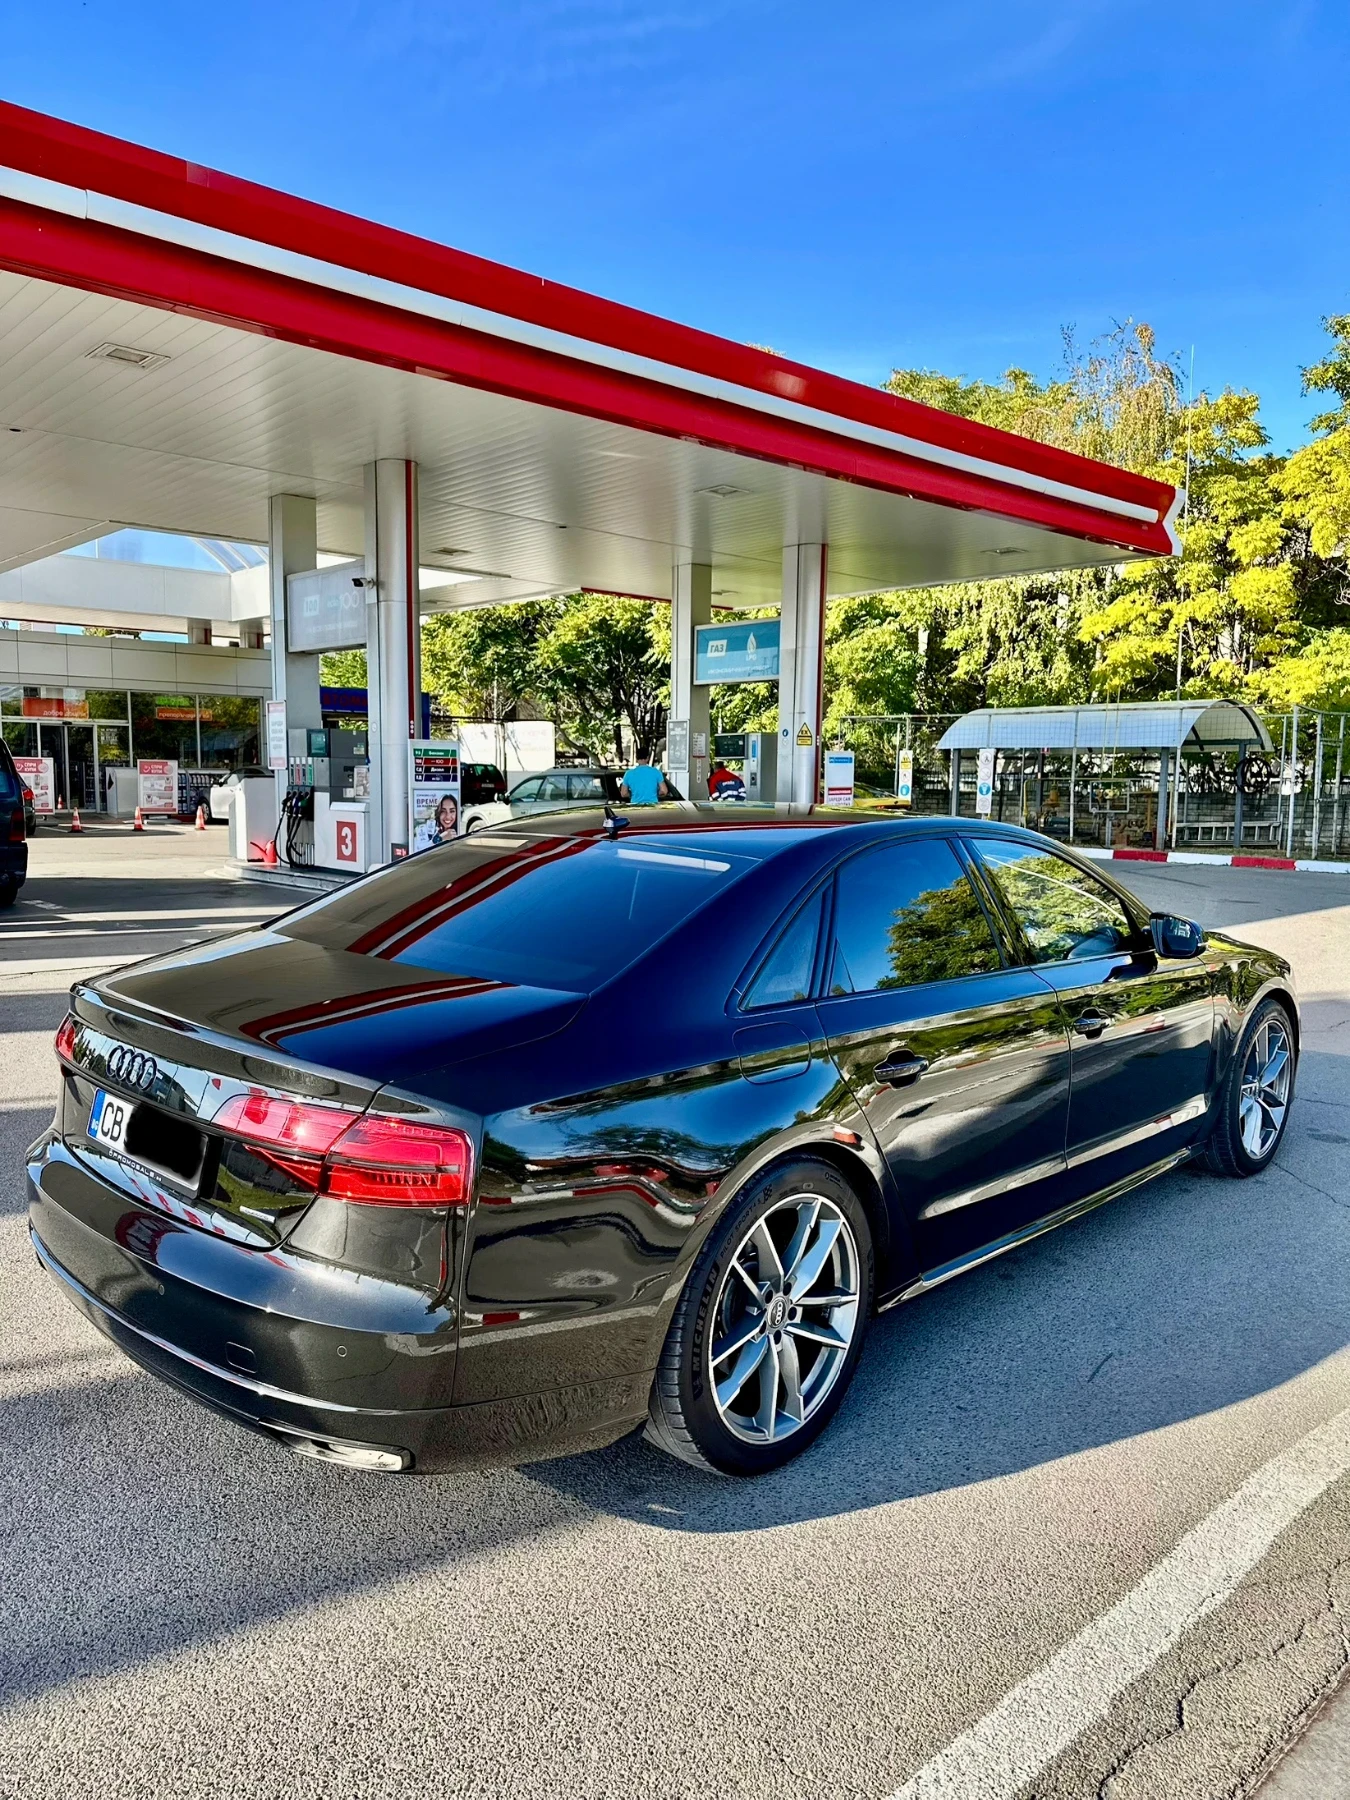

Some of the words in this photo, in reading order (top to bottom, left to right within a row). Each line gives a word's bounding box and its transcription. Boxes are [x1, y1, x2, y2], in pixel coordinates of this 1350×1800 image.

[710, 644, 725, 653] ГАЗ
[341, 826, 353, 857] 3
[720, 1233, 735, 1258] PILOT
[734, 1206, 754, 1232] SPORT
[692, 1268, 719, 1373] MICHELIN
